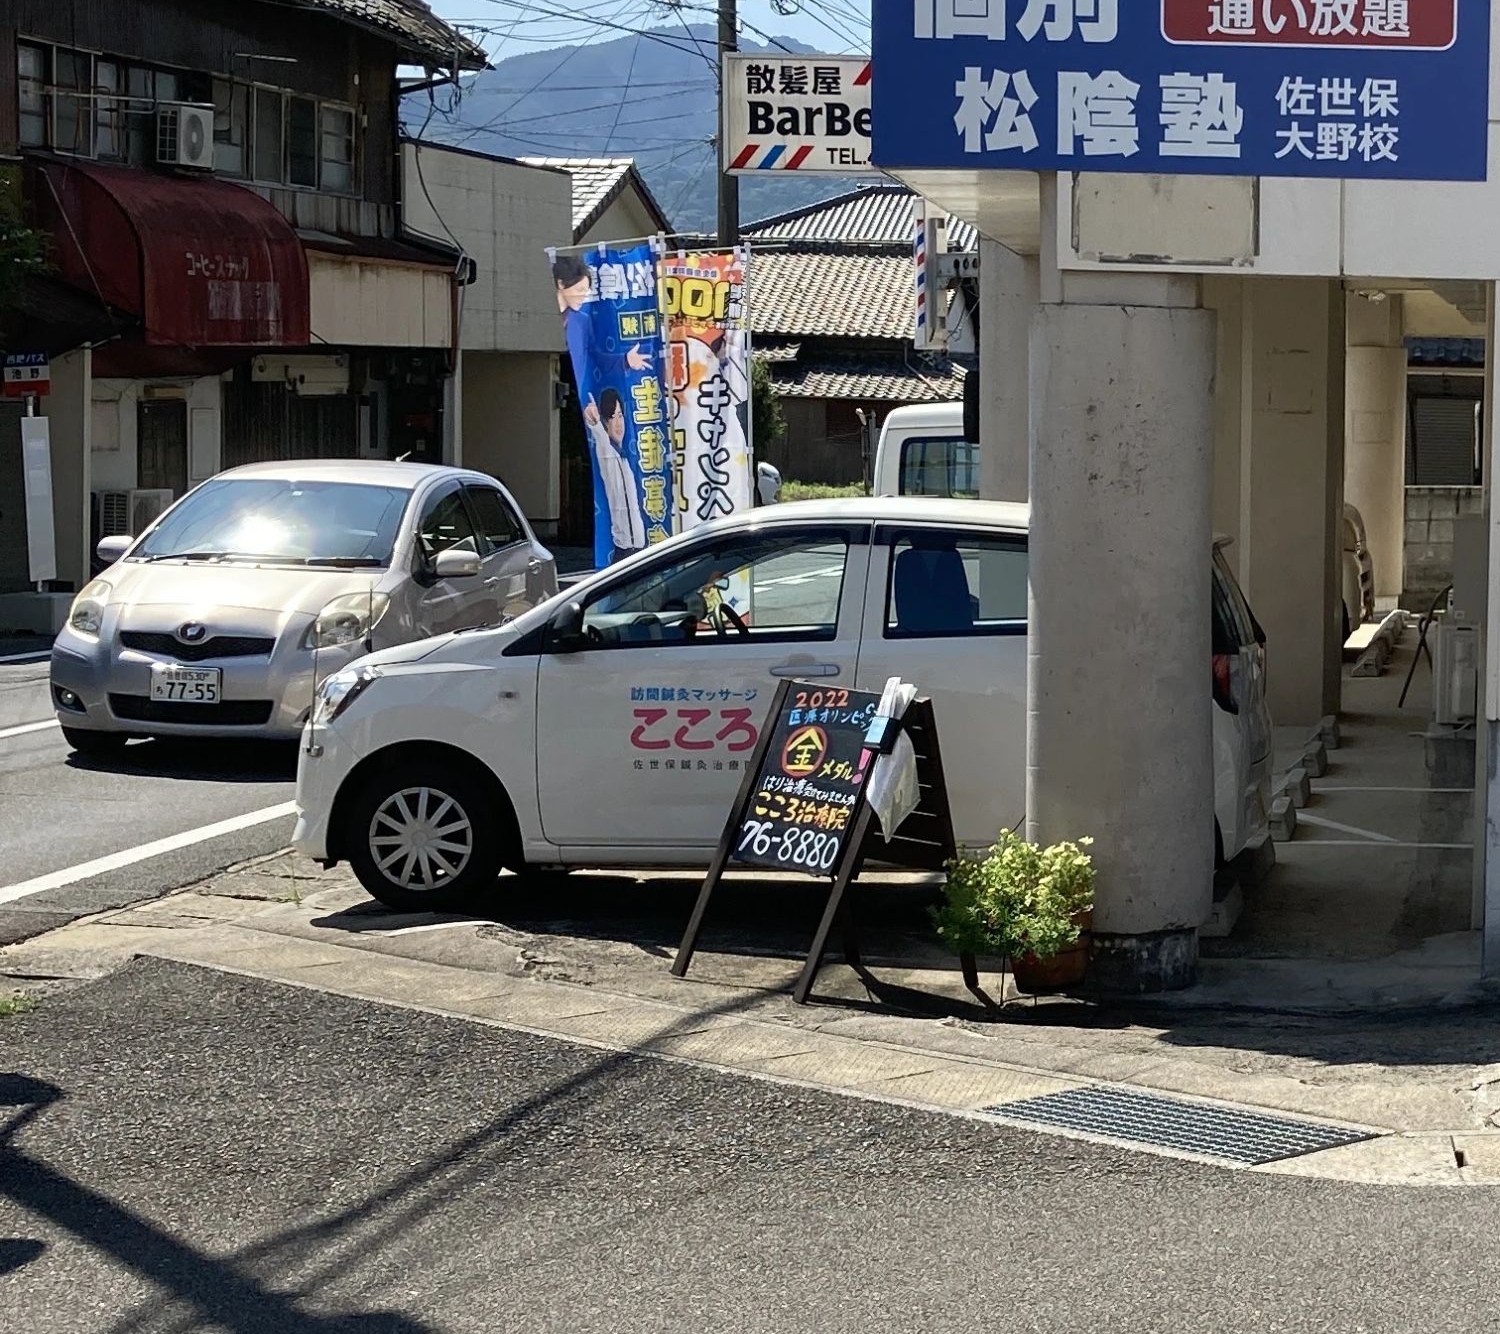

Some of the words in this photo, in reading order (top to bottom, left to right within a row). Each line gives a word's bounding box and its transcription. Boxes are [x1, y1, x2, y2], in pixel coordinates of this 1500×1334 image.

[746, 64, 842, 95] 散髪屋
[953, 66, 1244, 159] 松陰塾
[1274, 76, 1400, 118] 佐世保
[826, 147, 872, 165] TEL.
[1274, 121, 1400, 163] 大野校
[630, 687, 758, 701] 訪問鍼灸マッサージ
[795, 690, 849, 707] 2022
[630, 708, 758, 751] こころ
[755, 791, 850, 830] こころ治療院
[738, 820, 839, 869] 76-8880
